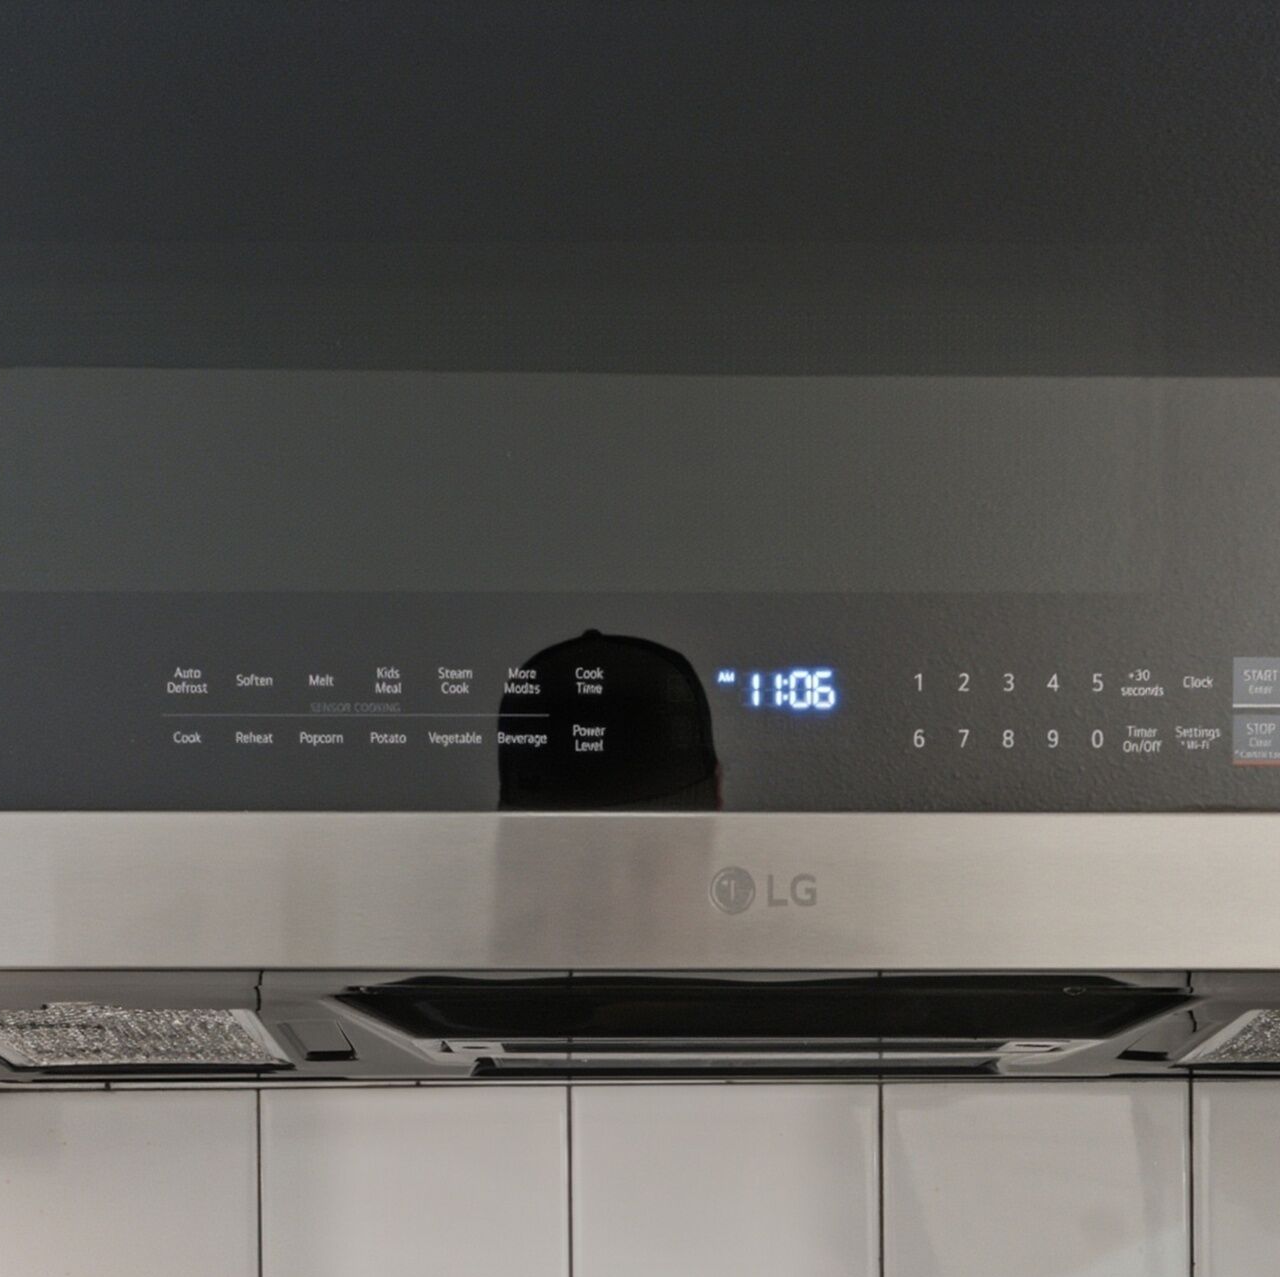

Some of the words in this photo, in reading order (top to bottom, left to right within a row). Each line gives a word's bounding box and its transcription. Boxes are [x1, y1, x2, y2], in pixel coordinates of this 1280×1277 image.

[174, 667, 202, 679] Auto
[236, 673, 273, 686] Soften
[377, 667, 400, 679] Kids
[438, 667, 473, 679] Steam
[508, 667, 537, 679] More
[575, 667, 604, 679] Cook
[1243, 669, 1278, 681] START
[308, 674, 334, 686] Melt
[913, 673, 923, 692] 1
[958, 673, 970, 692] 2
[1003, 673, 1015, 692] 3
[1047, 673, 1060, 692] 4
[1092, 673, 1104, 692] 5
[1183, 676, 1214, 688] Clock
[167, 681, 208, 694] Defrost
[375, 682, 402, 694] Meal
[440, 682, 470, 694] Cook
[504, 682, 541, 694] Modes
[576, 682, 603, 694] Time
[751, 669, 837, 709] 11:06
[1121, 684, 1164, 696] seconds
[572, 724, 606, 737] Power
[1126, 725, 1158, 737] Timer
[1175, 725, 1221, 741] Settings
[1246, 722, 1276, 735] STOP
[173, 731, 202, 744] Cook
[235, 731, 273, 744] Reheat
[299, 731, 344, 747] Popcorn
[370, 731, 407, 744] Potato
[428, 731, 483, 747] Vegetable
[497, 731, 548, 747] Beverage
[913, 729, 925, 749] 6
[958, 729, 970, 749] 7
[1002, 729, 1015, 749] 8
[1047, 729, 1059, 749] 9
[1092, 729, 1104, 749] 0
[575, 739, 604, 752] Level
[1122, 740, 1162, 753] On/Off
[766, 873, 818, 907] LG
